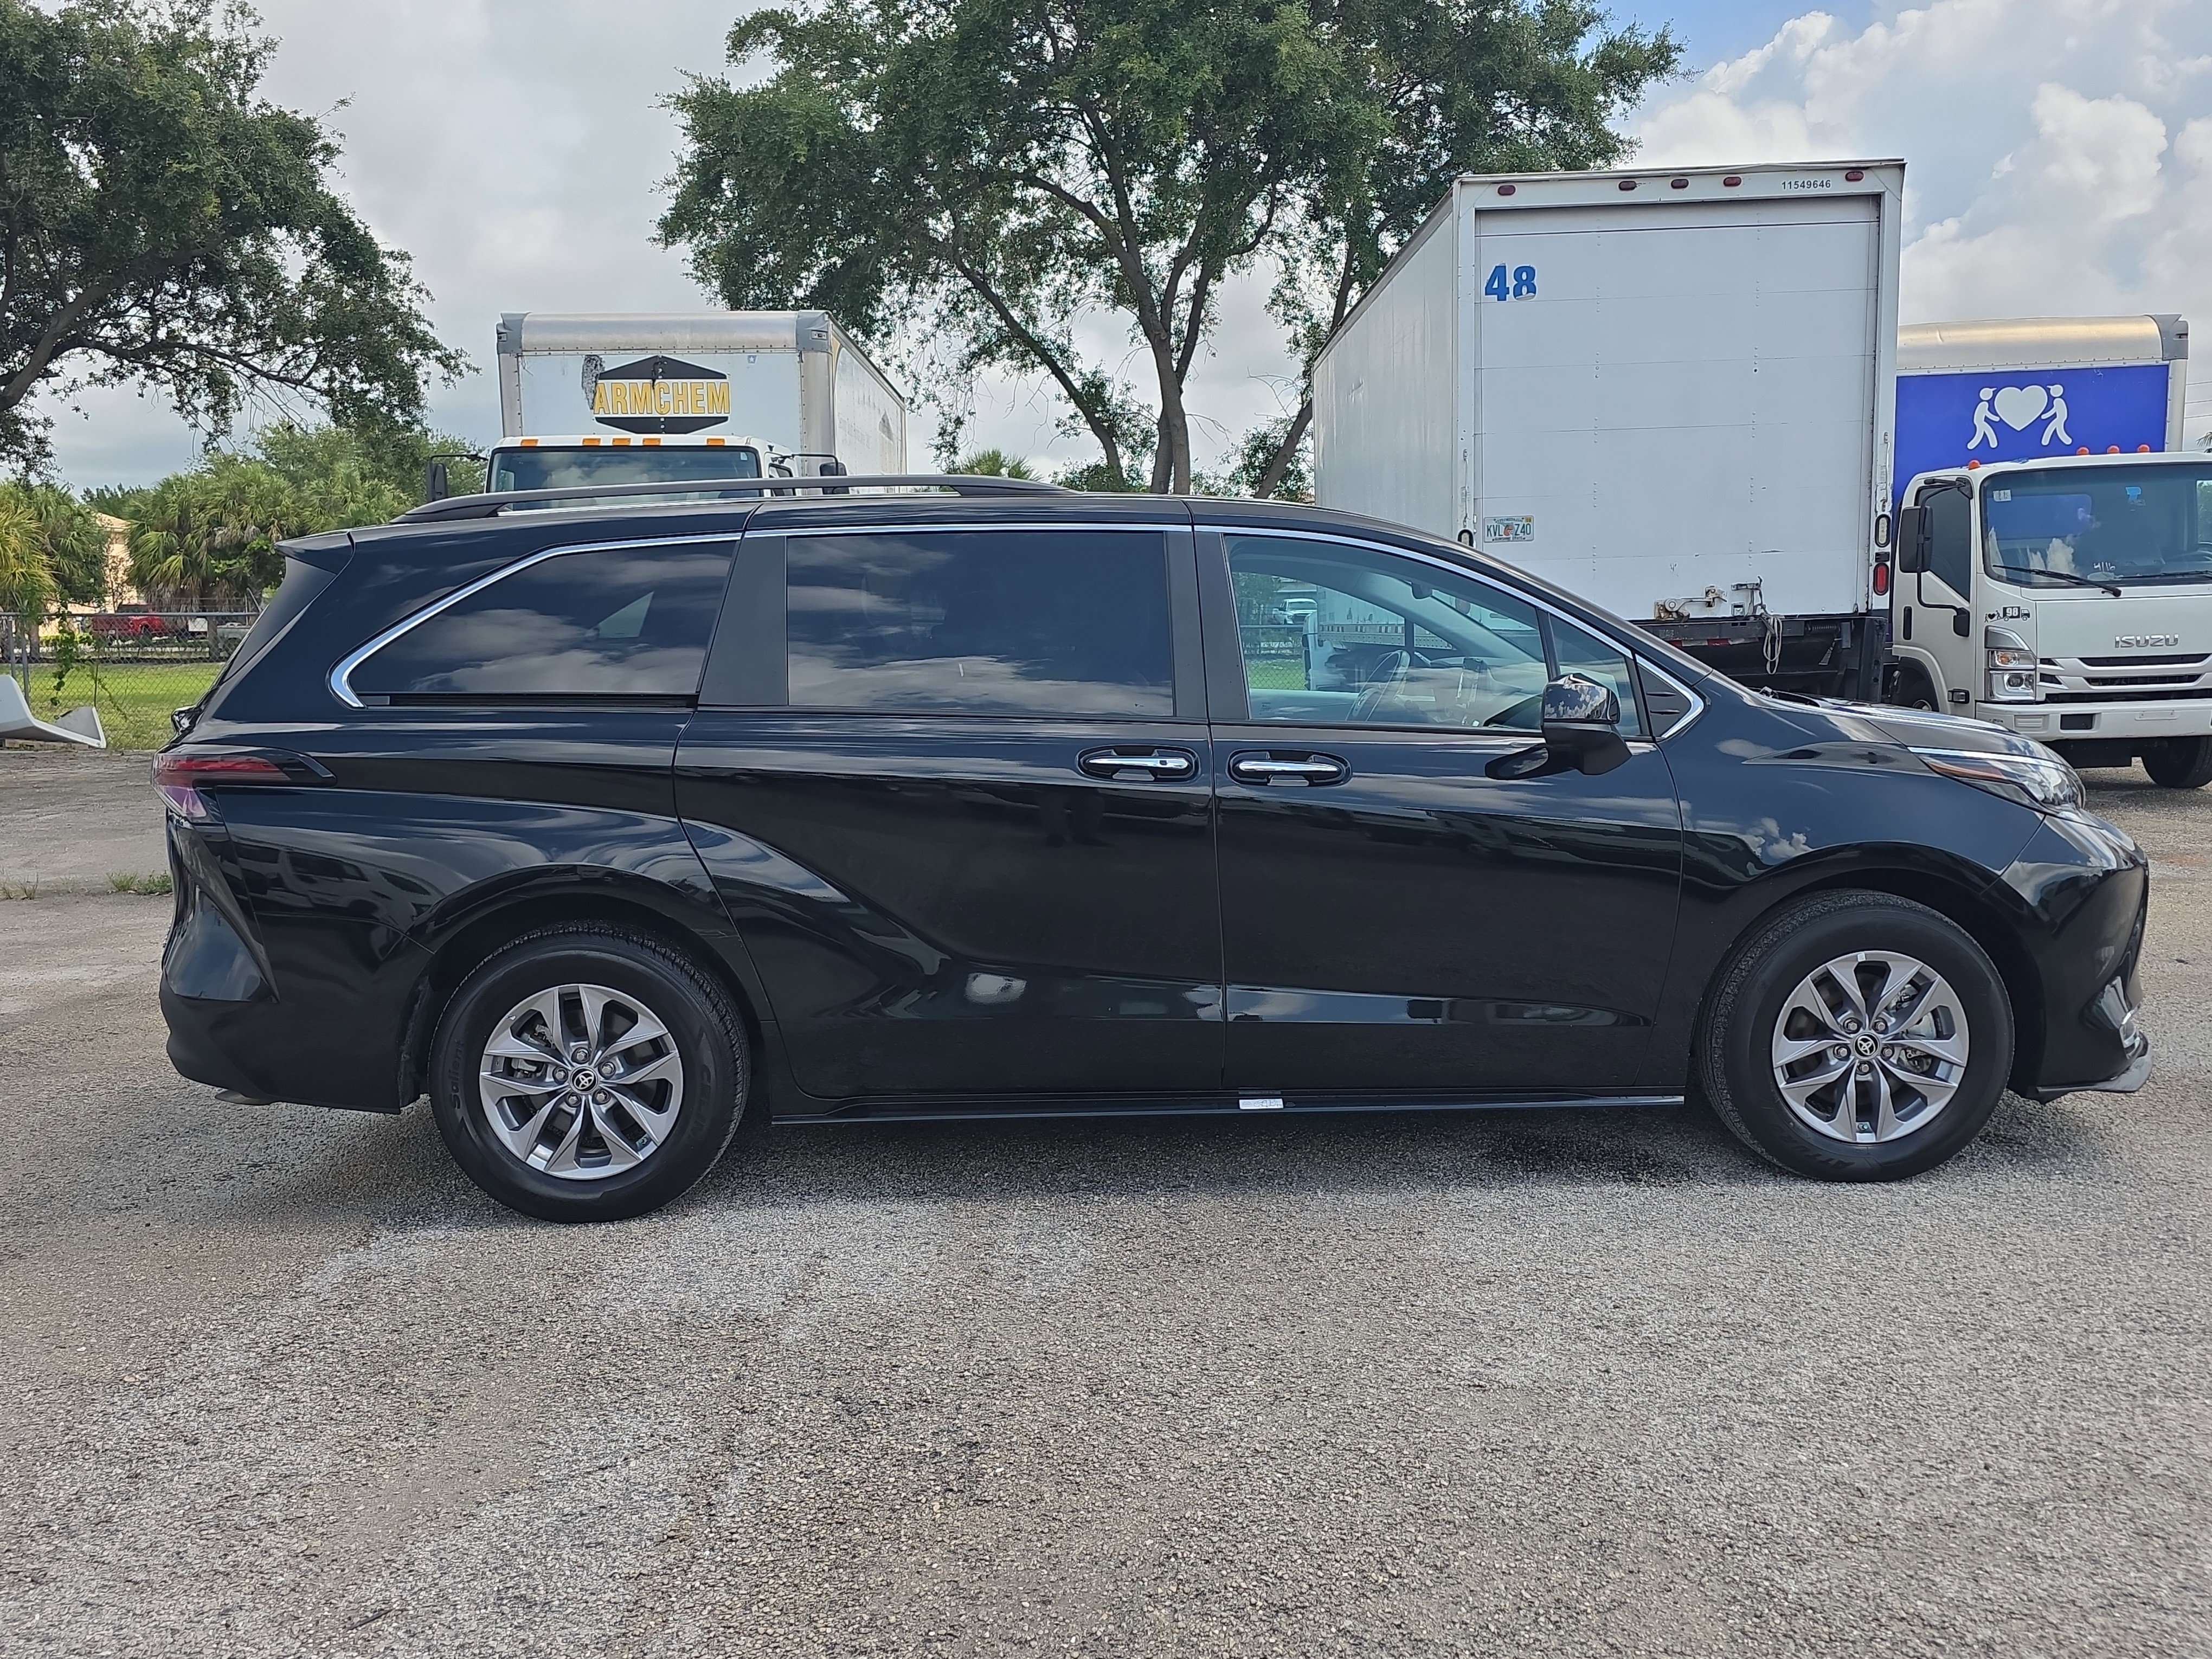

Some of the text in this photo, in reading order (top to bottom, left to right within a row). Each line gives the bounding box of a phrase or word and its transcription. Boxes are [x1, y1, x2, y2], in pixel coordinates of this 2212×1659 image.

[1782, 179, 1831, 190] 11549646
[1484, 266, 1536, 301] 48
[593, 382, 730, 415] ARMCHEM
[1487, 523, 1531, 537] KVL Z40
[2006, 607, 2018, 617] 98
[2114, 634, 2179, 648] ISUZU
[448, 1039, 465, 1110] Salient
